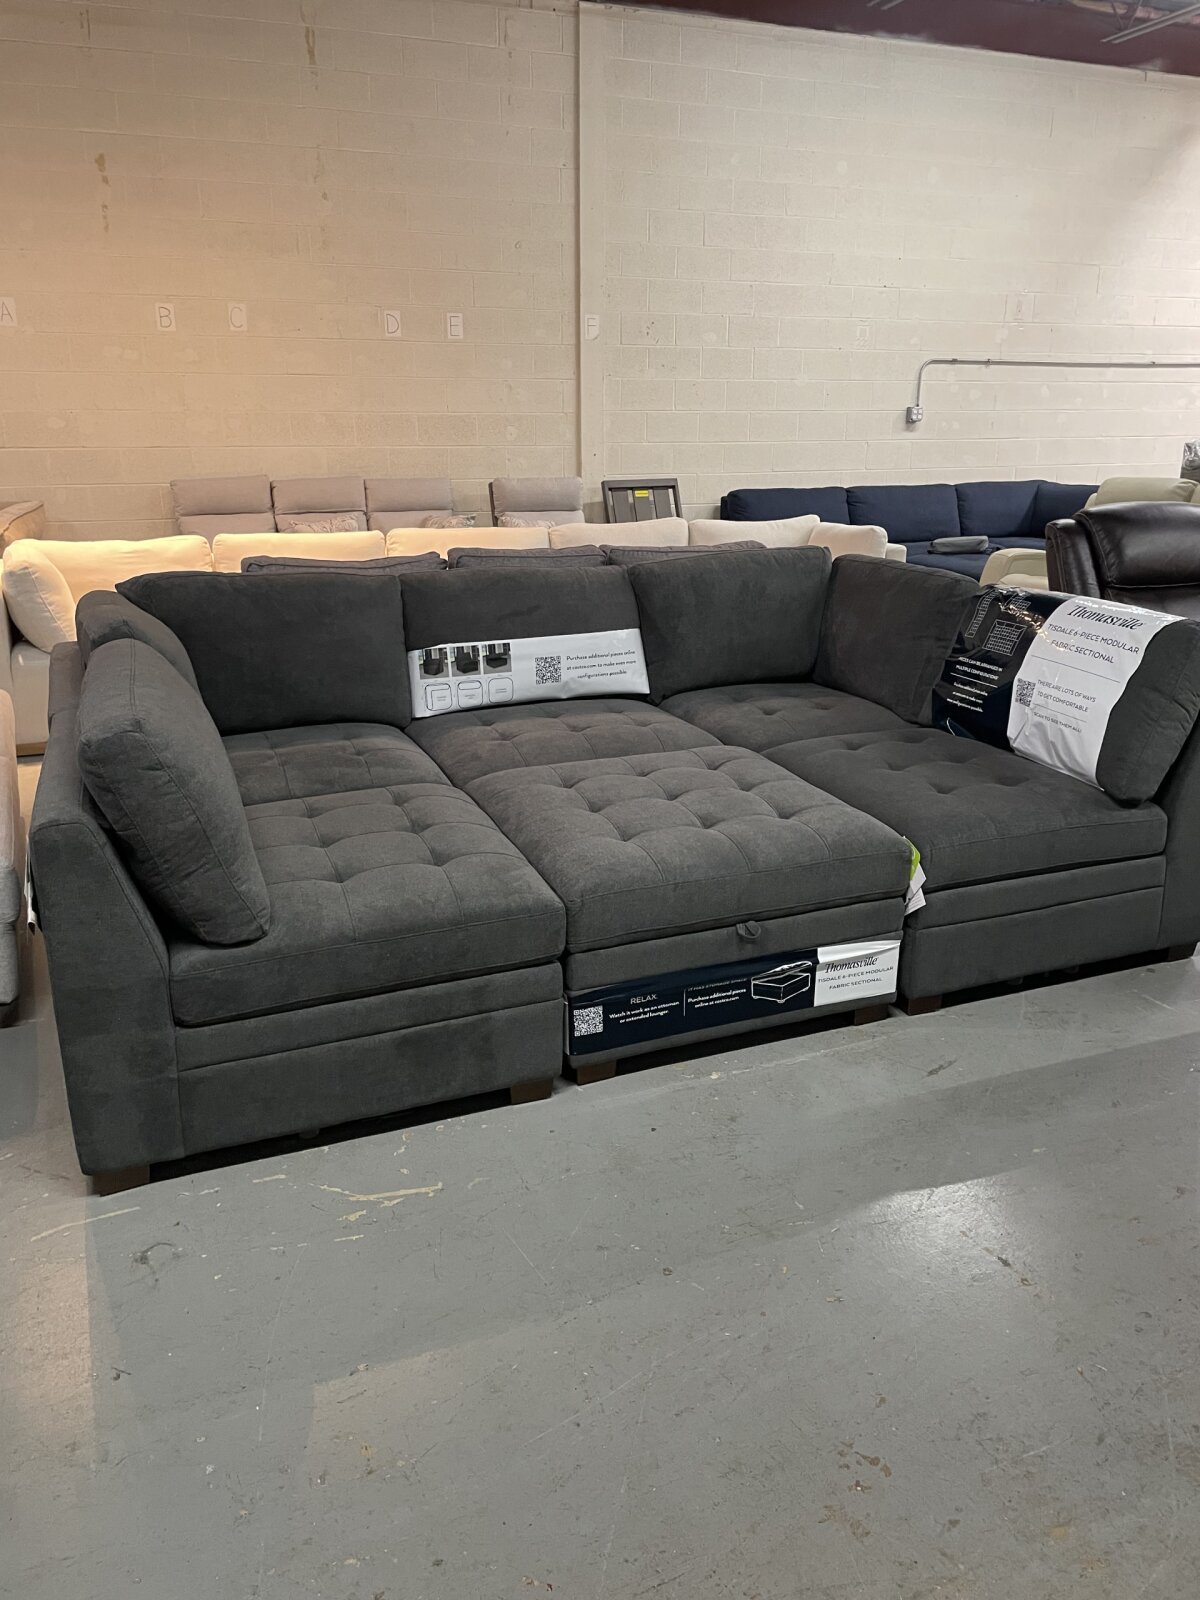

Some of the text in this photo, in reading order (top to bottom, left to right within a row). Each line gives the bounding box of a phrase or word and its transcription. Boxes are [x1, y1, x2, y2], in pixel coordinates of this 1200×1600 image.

[1, 302, 14, 322] A
[158, 306, 173, 329] B
[229, 306, 244, 329] C
[385, 313, 400, 335] D
[449, 315, 460, 337] E
[586, 317, 597, 337] F
[1067, 604, 1144, 631] Thomasville
[1047, 623, 1140, 654] TISDALE 6-PIECE MODULAR
[1051, 639, 1115, 664] FABRIC SECTIONAL
[1052, 696, 1089, 713] COMFORTABLE
[1061, 688, 1074, 696] LOTS
[1082, 694, 1096, 703] WAYS
[818, 975, 841, 983] TISDALE
[865, 966, 894, 975] MODULAR
[825, 955, 878, 974] Thomasville
[829, 977, 882, 990] FABRIC SECTIONAL
[630, 993, 657, 1005] RELAX
[609, 1011, 625, 1019] Watch
